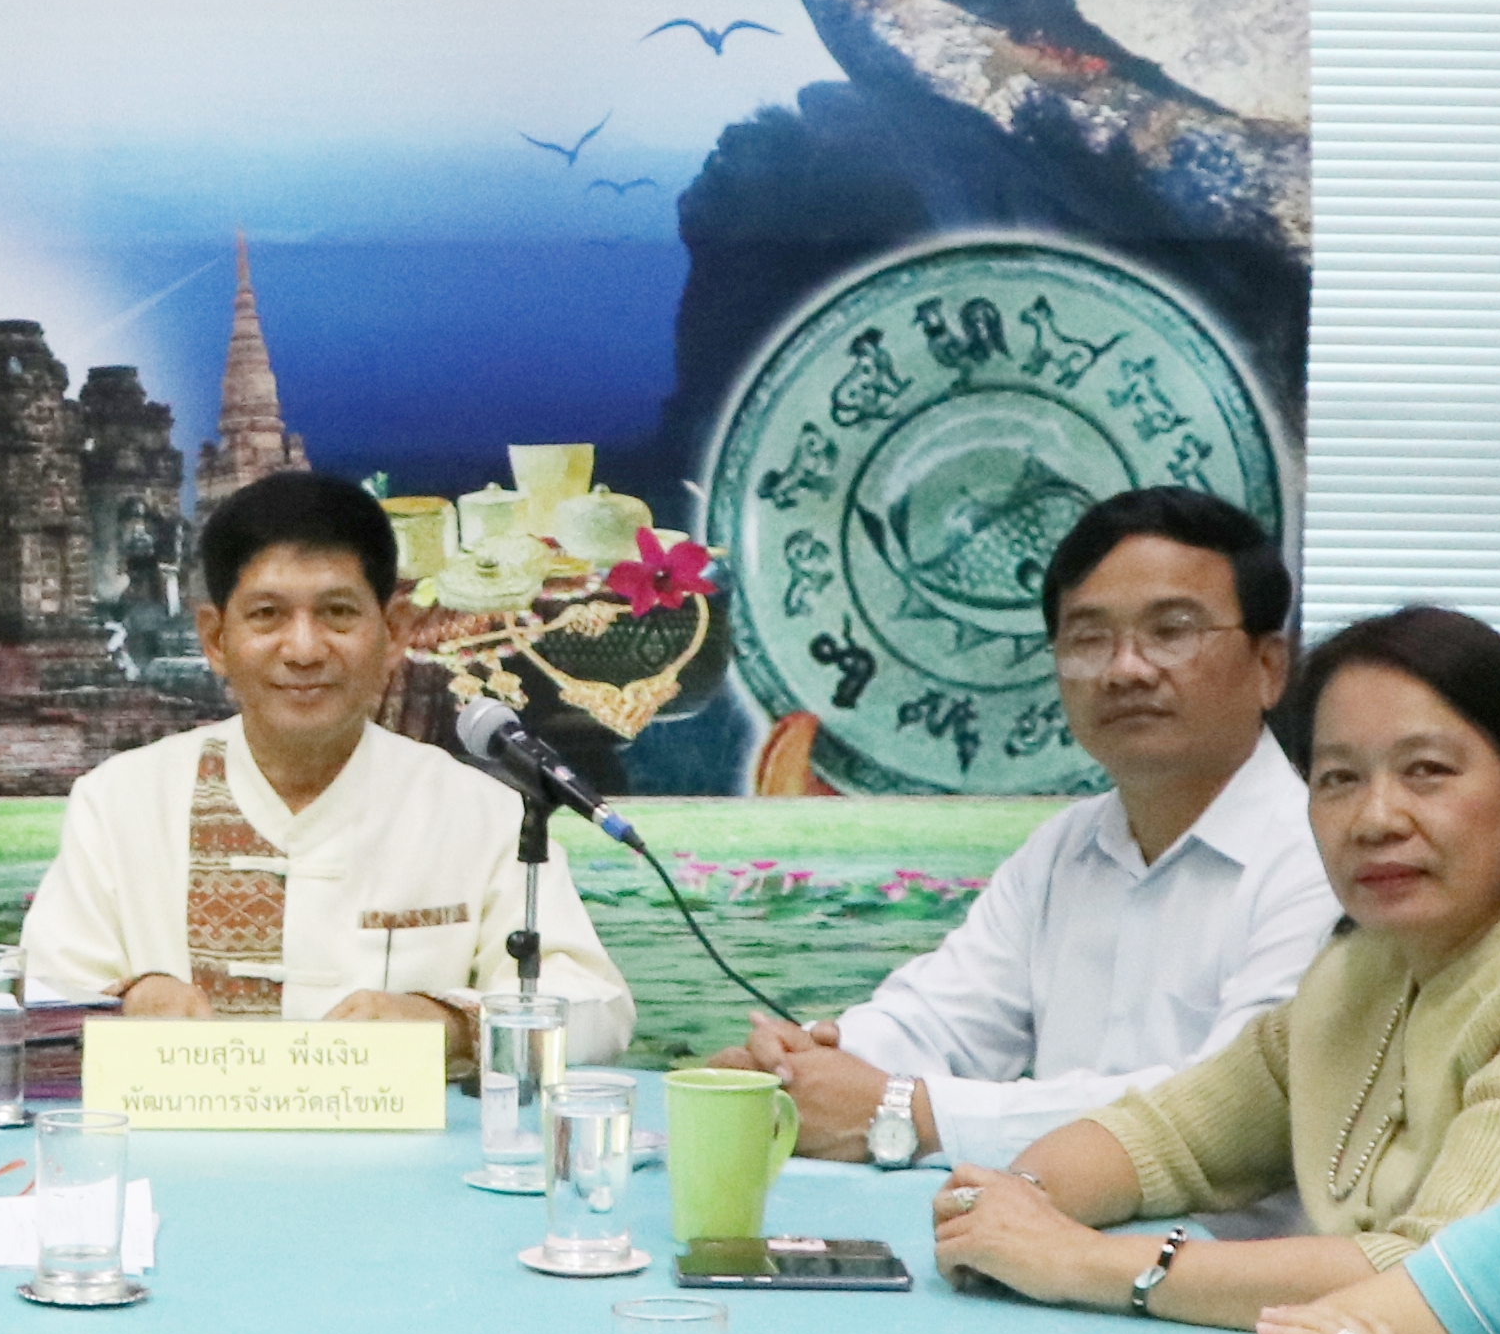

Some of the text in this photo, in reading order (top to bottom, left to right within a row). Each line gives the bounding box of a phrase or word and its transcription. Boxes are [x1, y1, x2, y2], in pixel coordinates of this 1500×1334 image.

[156, 1037, 266, 1076] นายสุวิน
[120, 1085, 405, 1123] พัฒนาการจังหวัดสุโขทัย
